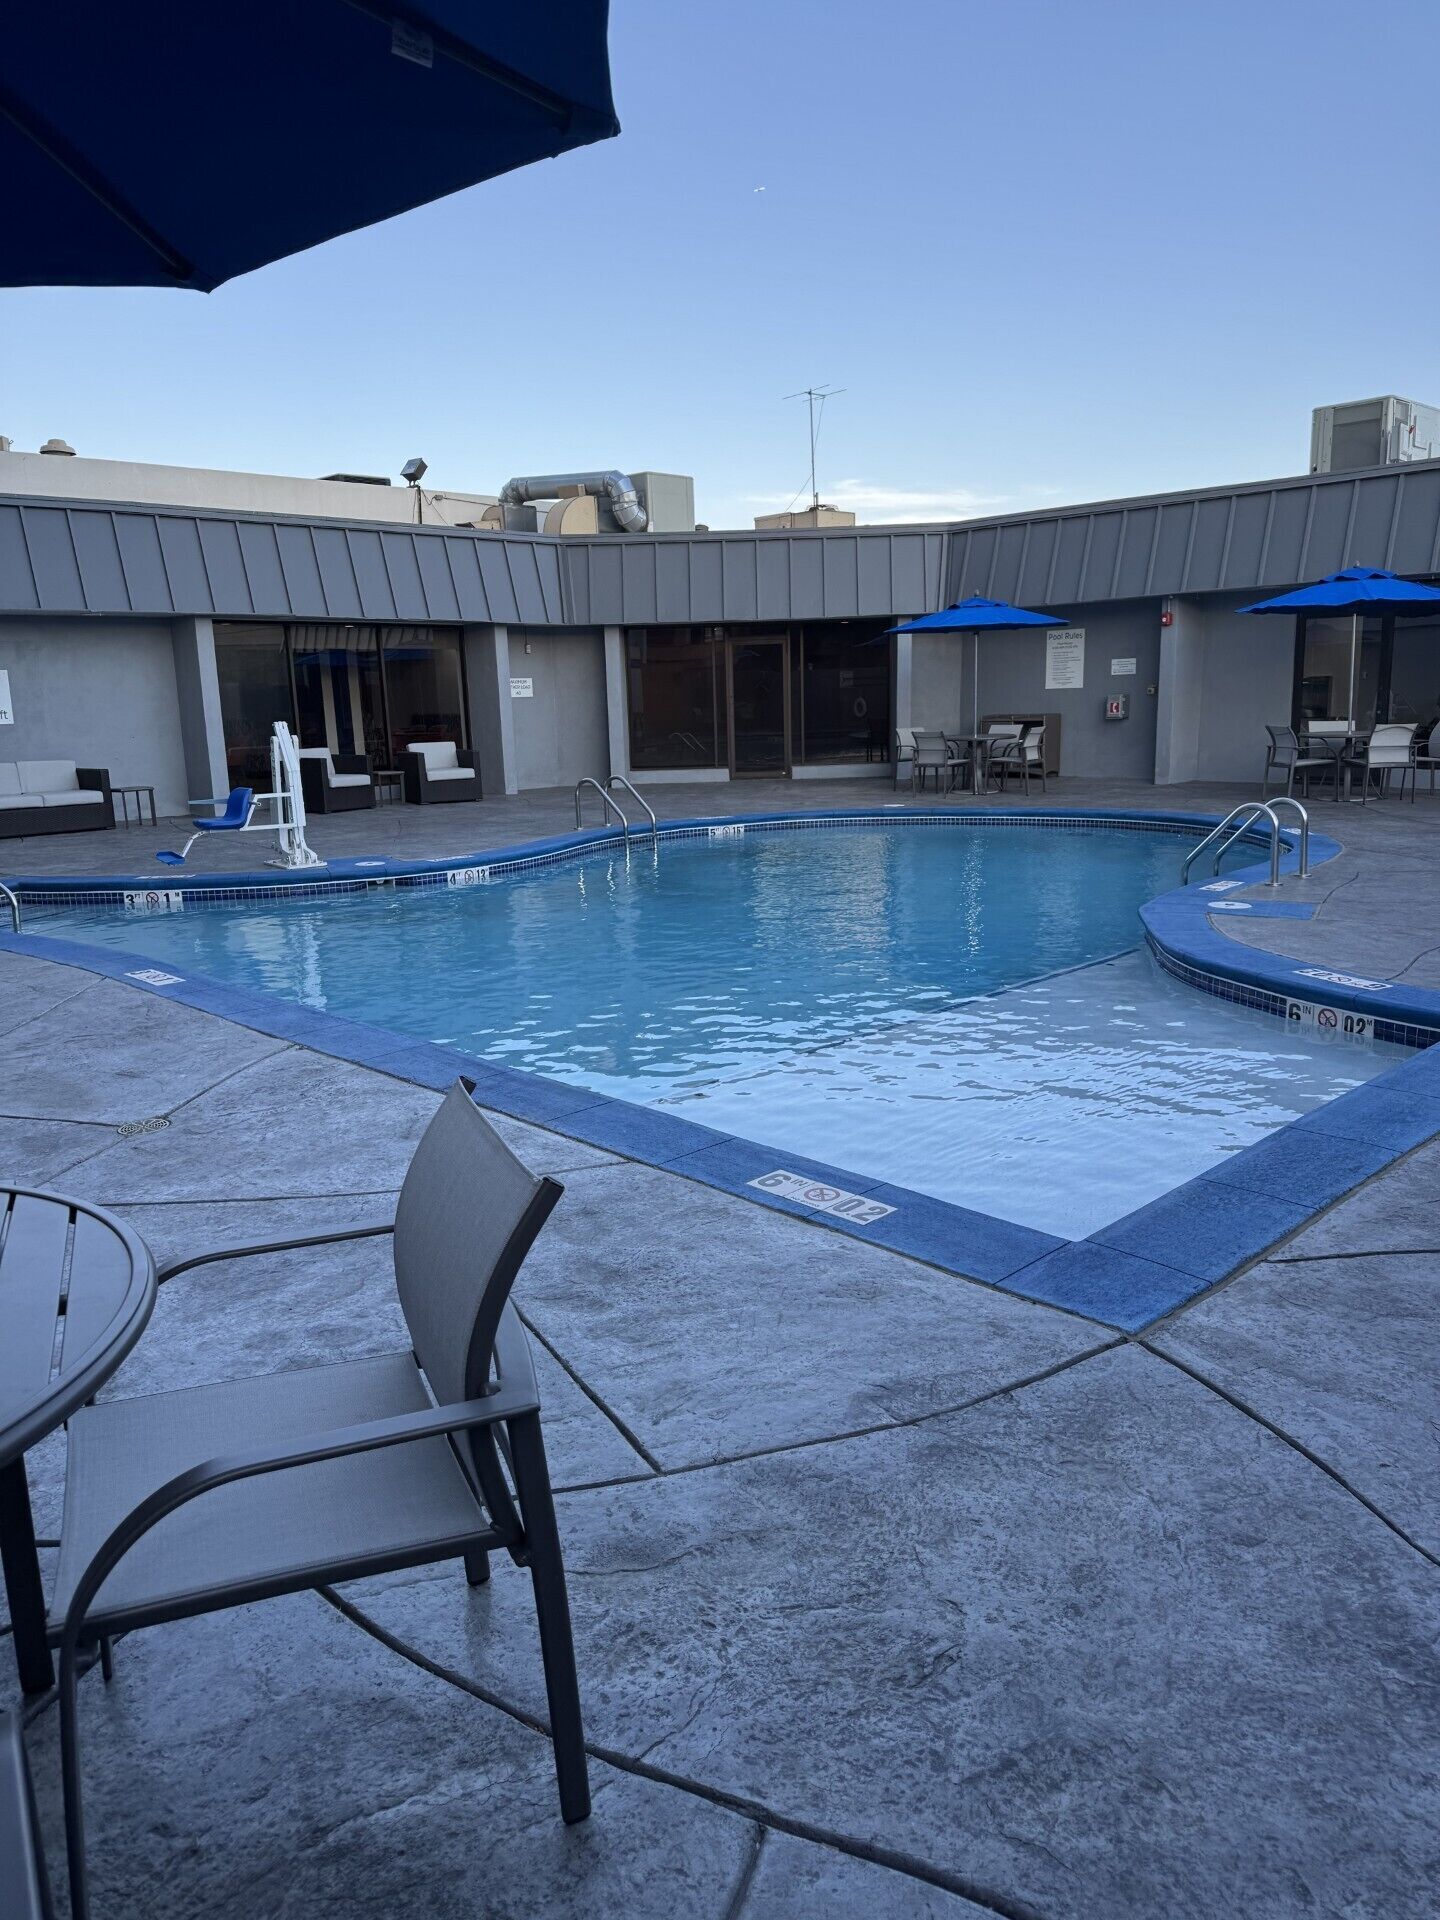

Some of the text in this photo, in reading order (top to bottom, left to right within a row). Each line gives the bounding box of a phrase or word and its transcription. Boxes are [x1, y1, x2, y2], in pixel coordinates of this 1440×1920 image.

[1048, 631, 1084, 641] Pool Rules
[757, 1173, 791, 1187] 6
